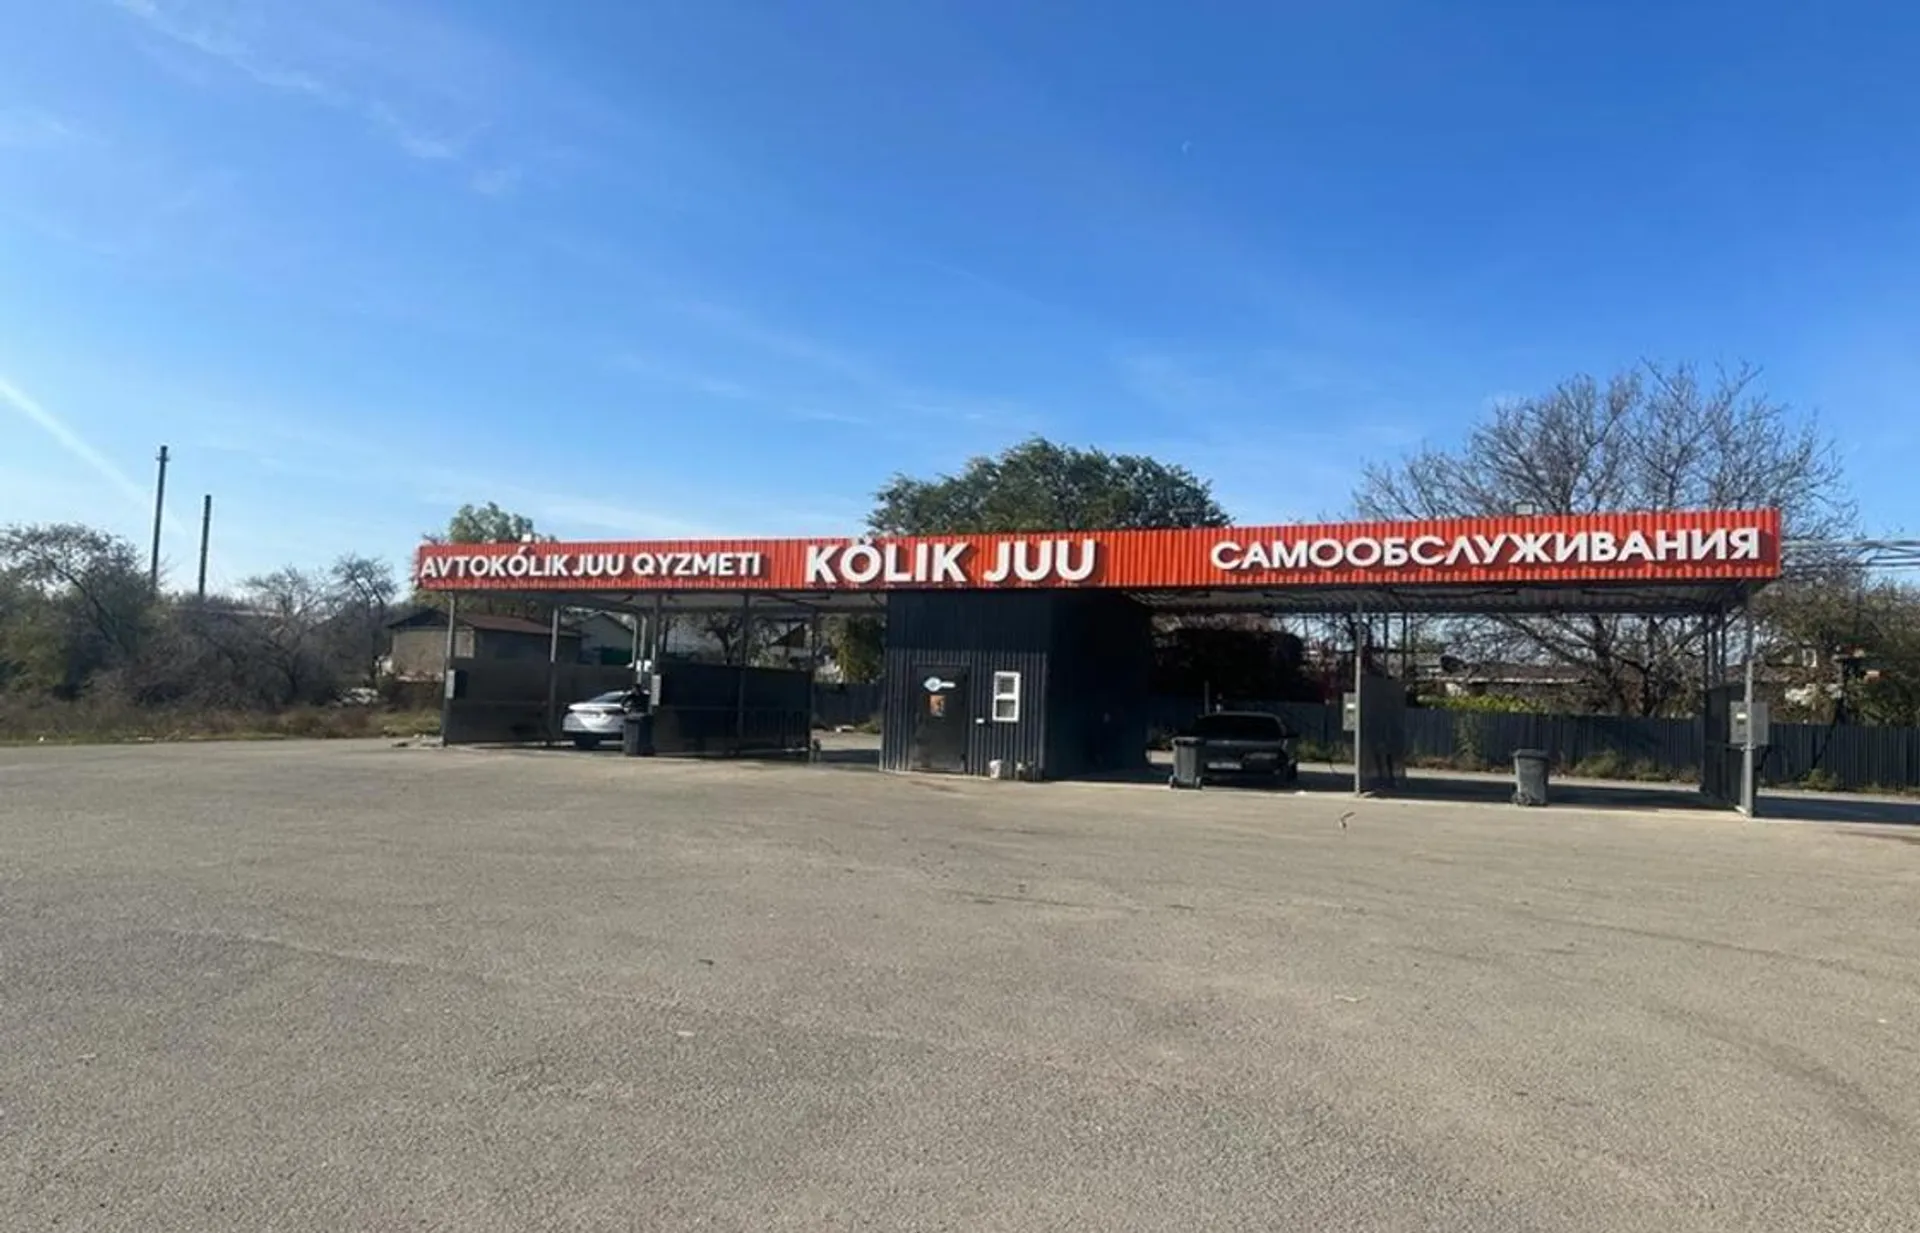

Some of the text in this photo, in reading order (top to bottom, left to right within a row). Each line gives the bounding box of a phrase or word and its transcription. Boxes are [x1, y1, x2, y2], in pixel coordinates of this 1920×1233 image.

[573, 553, 624, 577] JUU
[632, 552, 761, 576] QYZMETI
[983, 538, 1095, 582] JUU
[1210, 527, 1759, 571] САМООБСЛУЖИВАНИЯ
